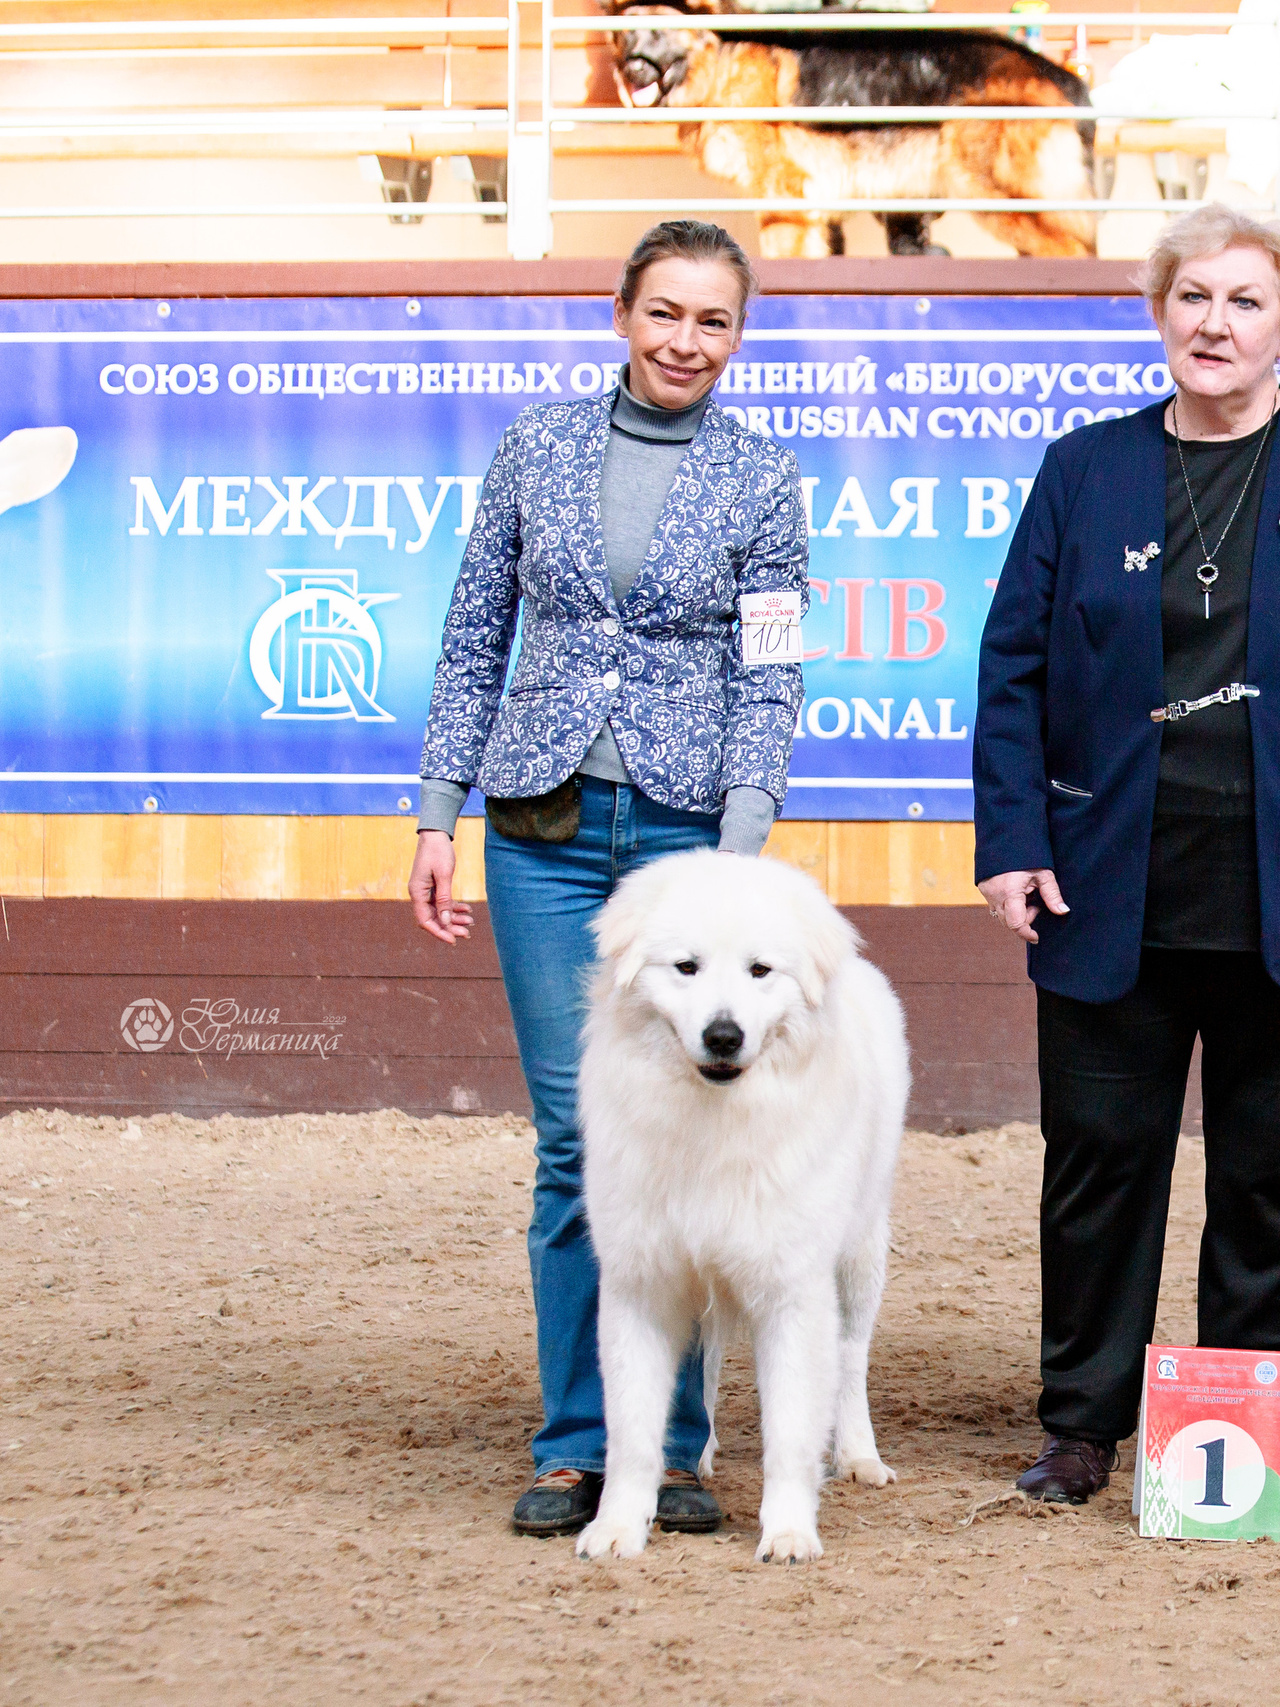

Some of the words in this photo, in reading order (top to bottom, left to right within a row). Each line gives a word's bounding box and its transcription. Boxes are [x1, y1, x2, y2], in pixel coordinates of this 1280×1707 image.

[99, 363, 219, 395] СОЮЗ
[227, 362, 563, 400] ОБЩЕСТВЕННЫХ
[570, 355, 878, 394] ОБНЕНИЙ
[885, 362, 1176, 402] «БЕЛОРУССКО
[722, 406, 920, 438] ORUSSIAN
[750, 610, 772, 618] ROYAL
[752, 618, 792, 655] 101
[1195, 1438, 1231, 1508] 1
